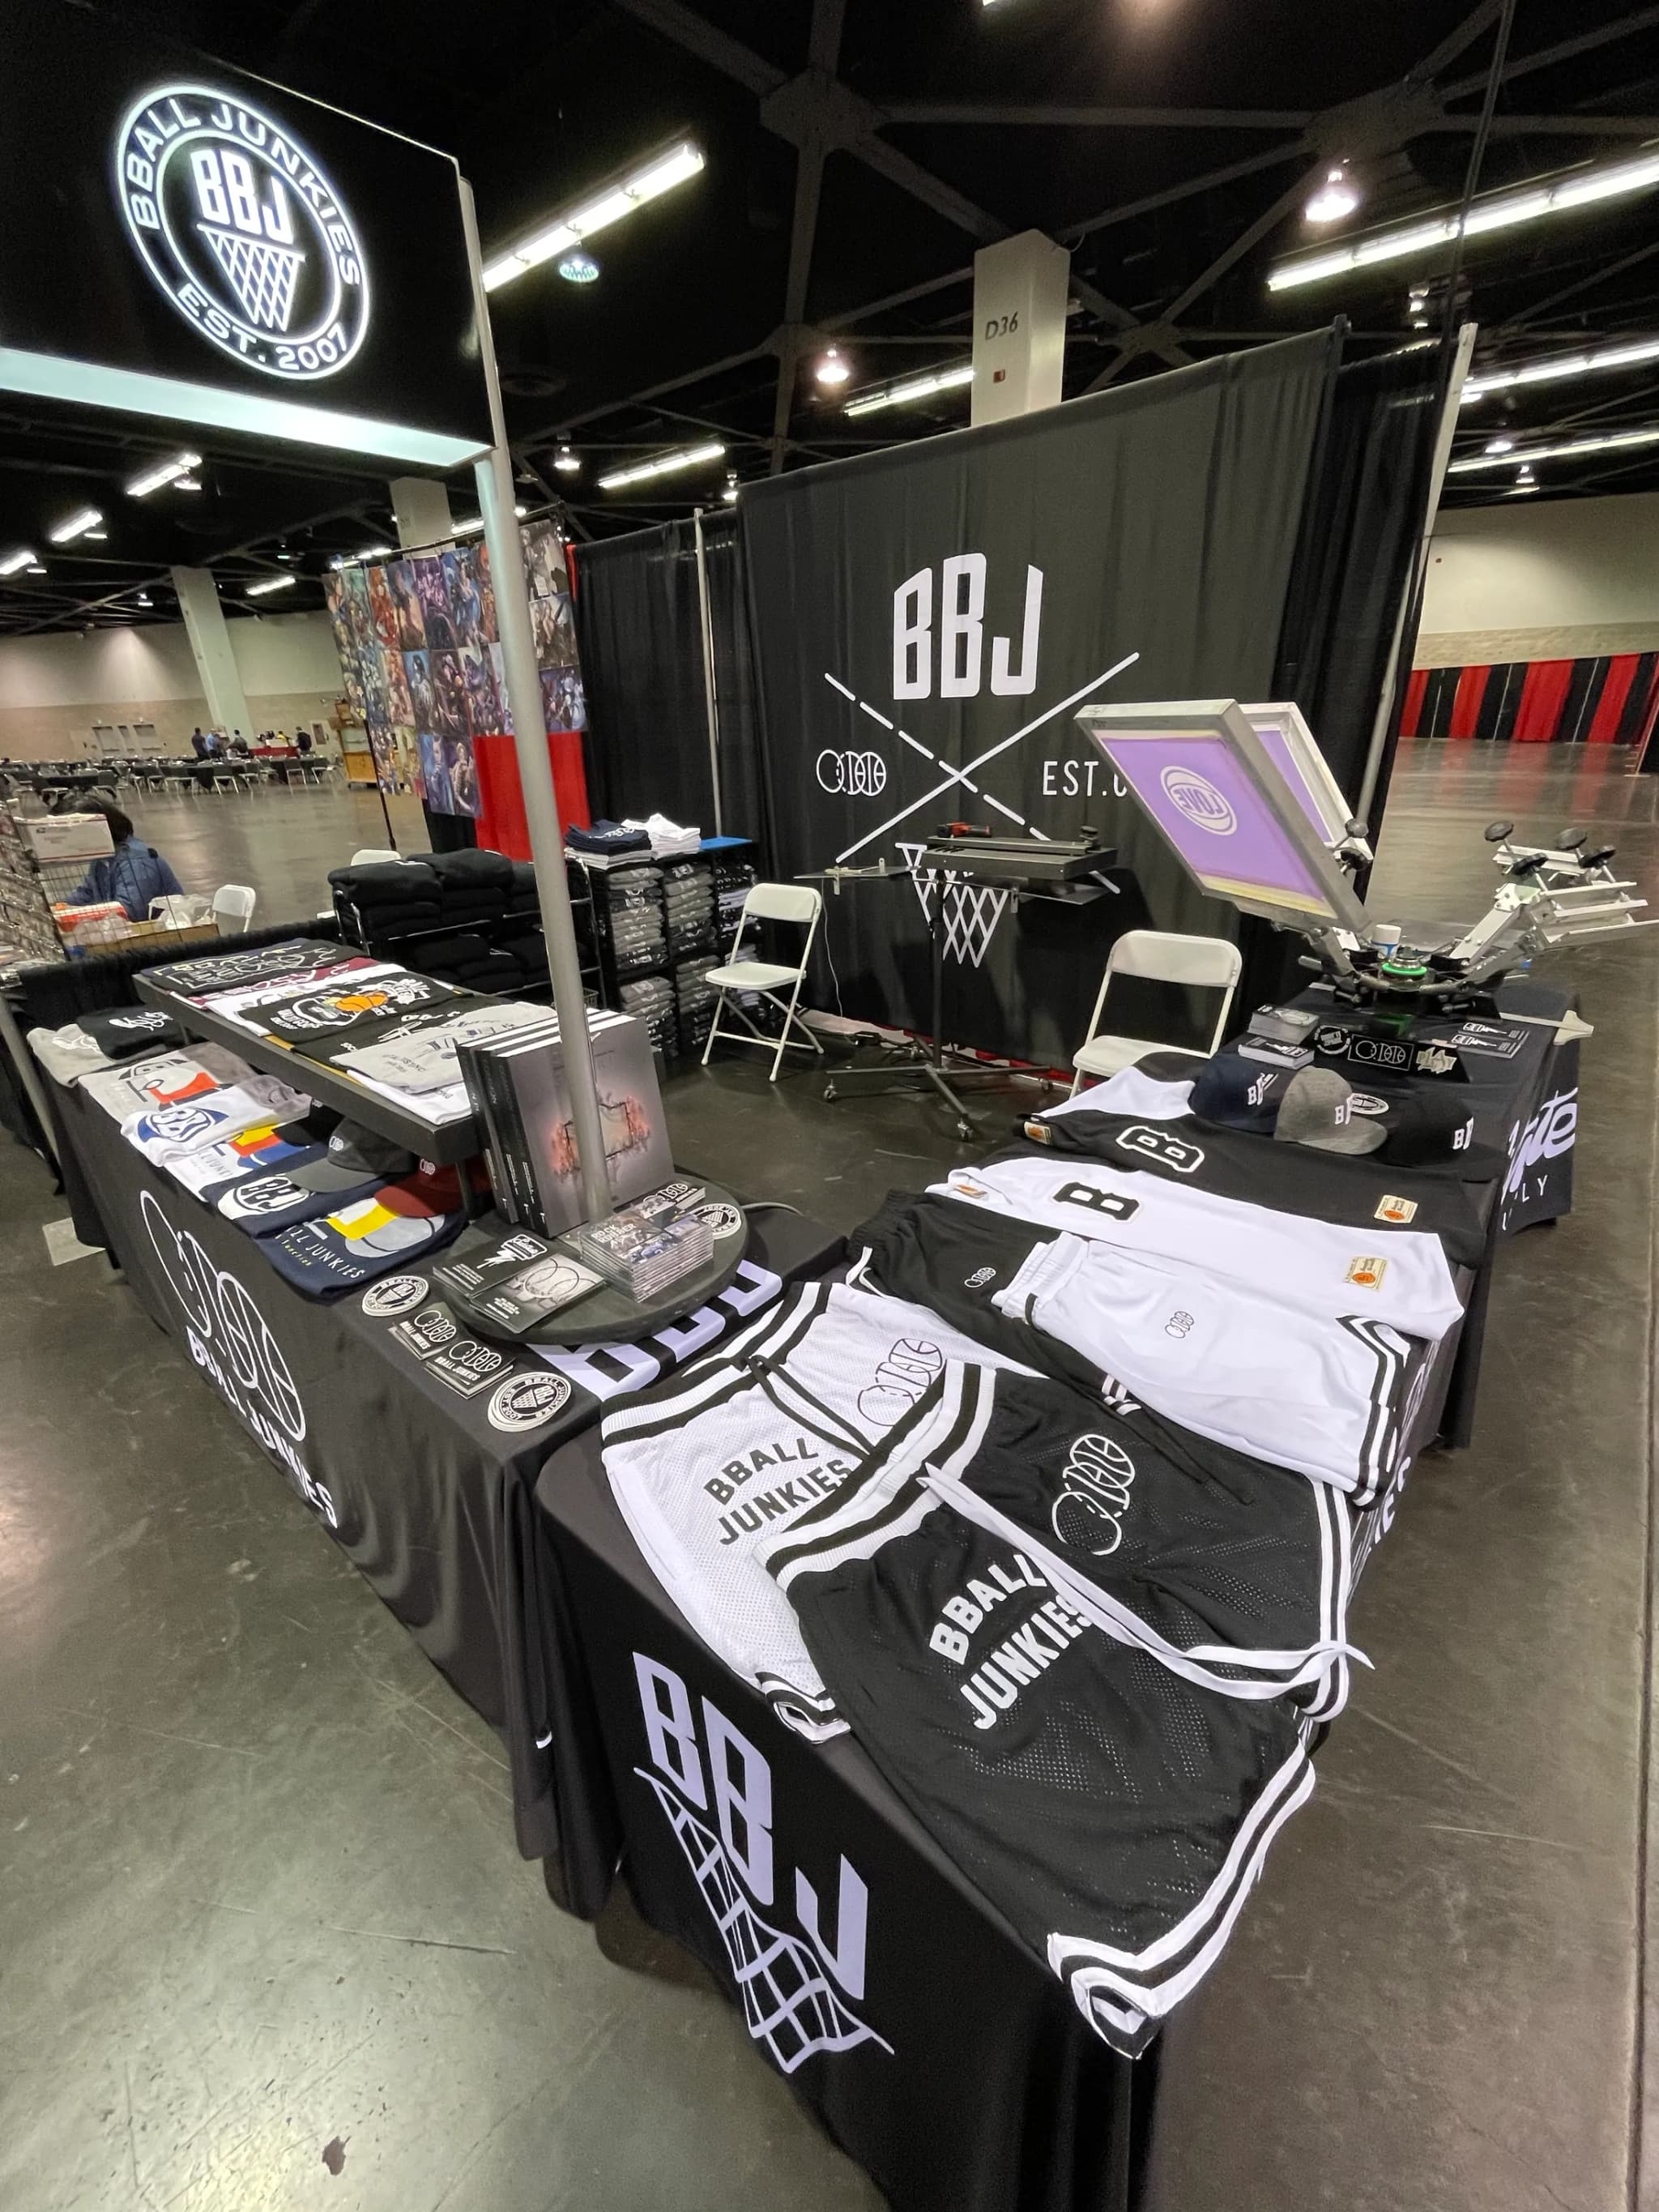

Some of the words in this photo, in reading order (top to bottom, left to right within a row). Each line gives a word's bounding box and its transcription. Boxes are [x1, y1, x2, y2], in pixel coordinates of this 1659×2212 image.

[127, 97, 202, 230] BBALL
[211, 103, 360, 286] JUNKIES
[190, 148, 294, 245] BBJ
[177, 283, 267, 363] EST.
[276, 322, 348, 370] 2007
[985, 311, 1019, 341] D36
[893, 553, 1043, 700] BBJ
[305, 1243, 365, 1279] JUNKIES
[704, 1437, 819, 1505] BBALL
[718, 1458, 853, 1546] JUNKIES
[928, 1553, 1048, 1665] BBALL
[632, 1650, 869, 2001] BBJ
